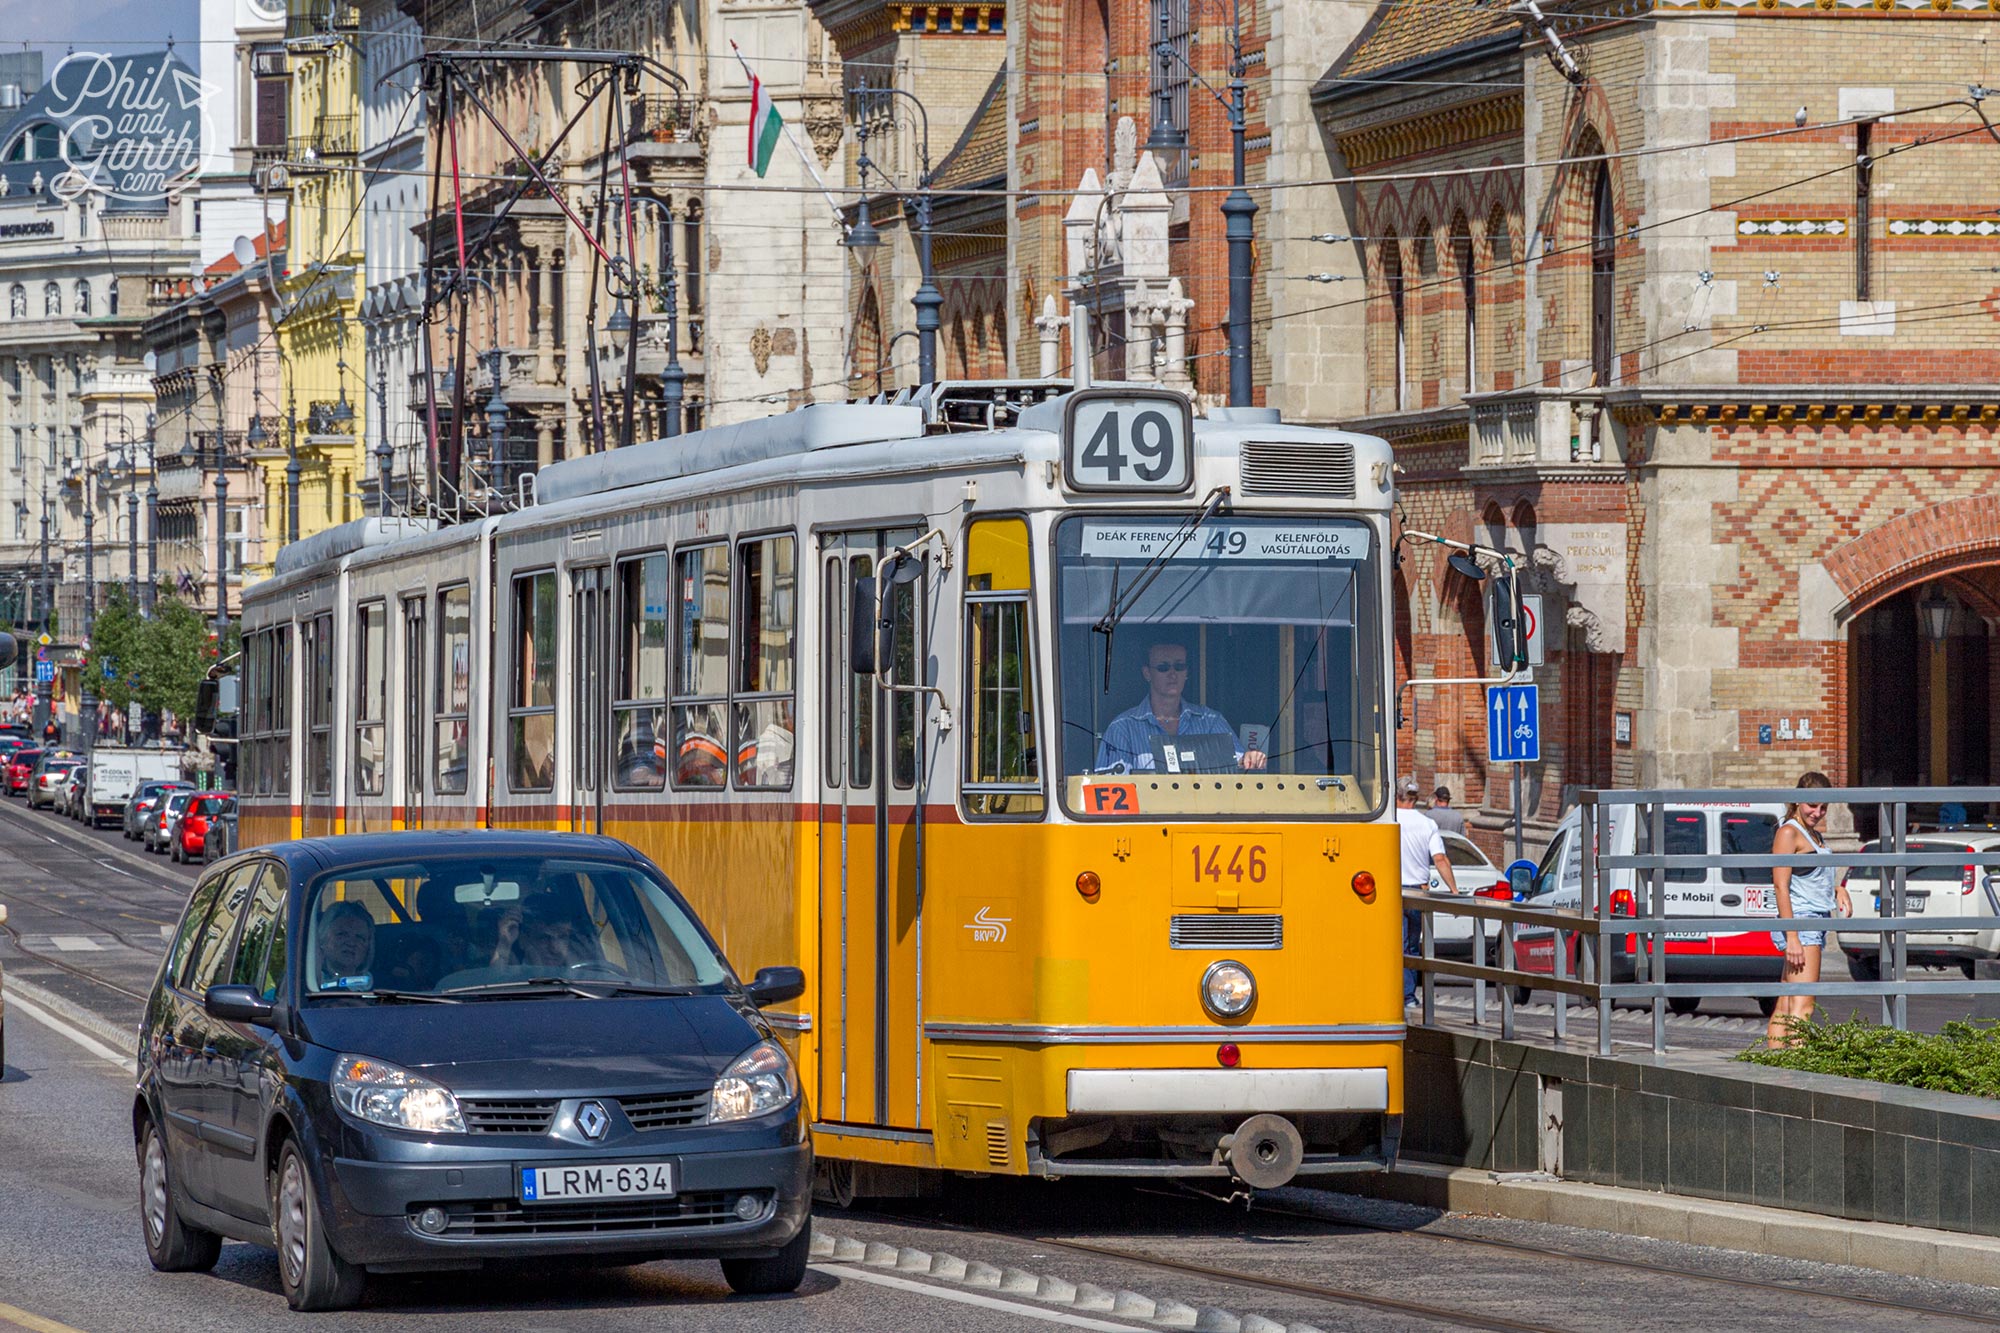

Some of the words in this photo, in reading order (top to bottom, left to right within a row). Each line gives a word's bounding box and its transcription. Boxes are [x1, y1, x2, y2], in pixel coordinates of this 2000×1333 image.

[1081, 410, 1174, 482] 49
[1096, 530, 1127, 541] DEÁK
[1131, 532, 1173, 541] FERENC
[1207, 531, 1247, 555] 49
[1275, 532, 1339, 543] KELENFÖLD
[1140, 544, 1151, 553] M
[1261, 543, 1350, 555] VASÚTÁLLOMÁS
[1095, 787, 1129, 811] F2
[1191, 844, 1267, 883] 1446
[1682, 892, 1714, 902] Mobil
[542, 1166, 667, 1196] LRM-634
